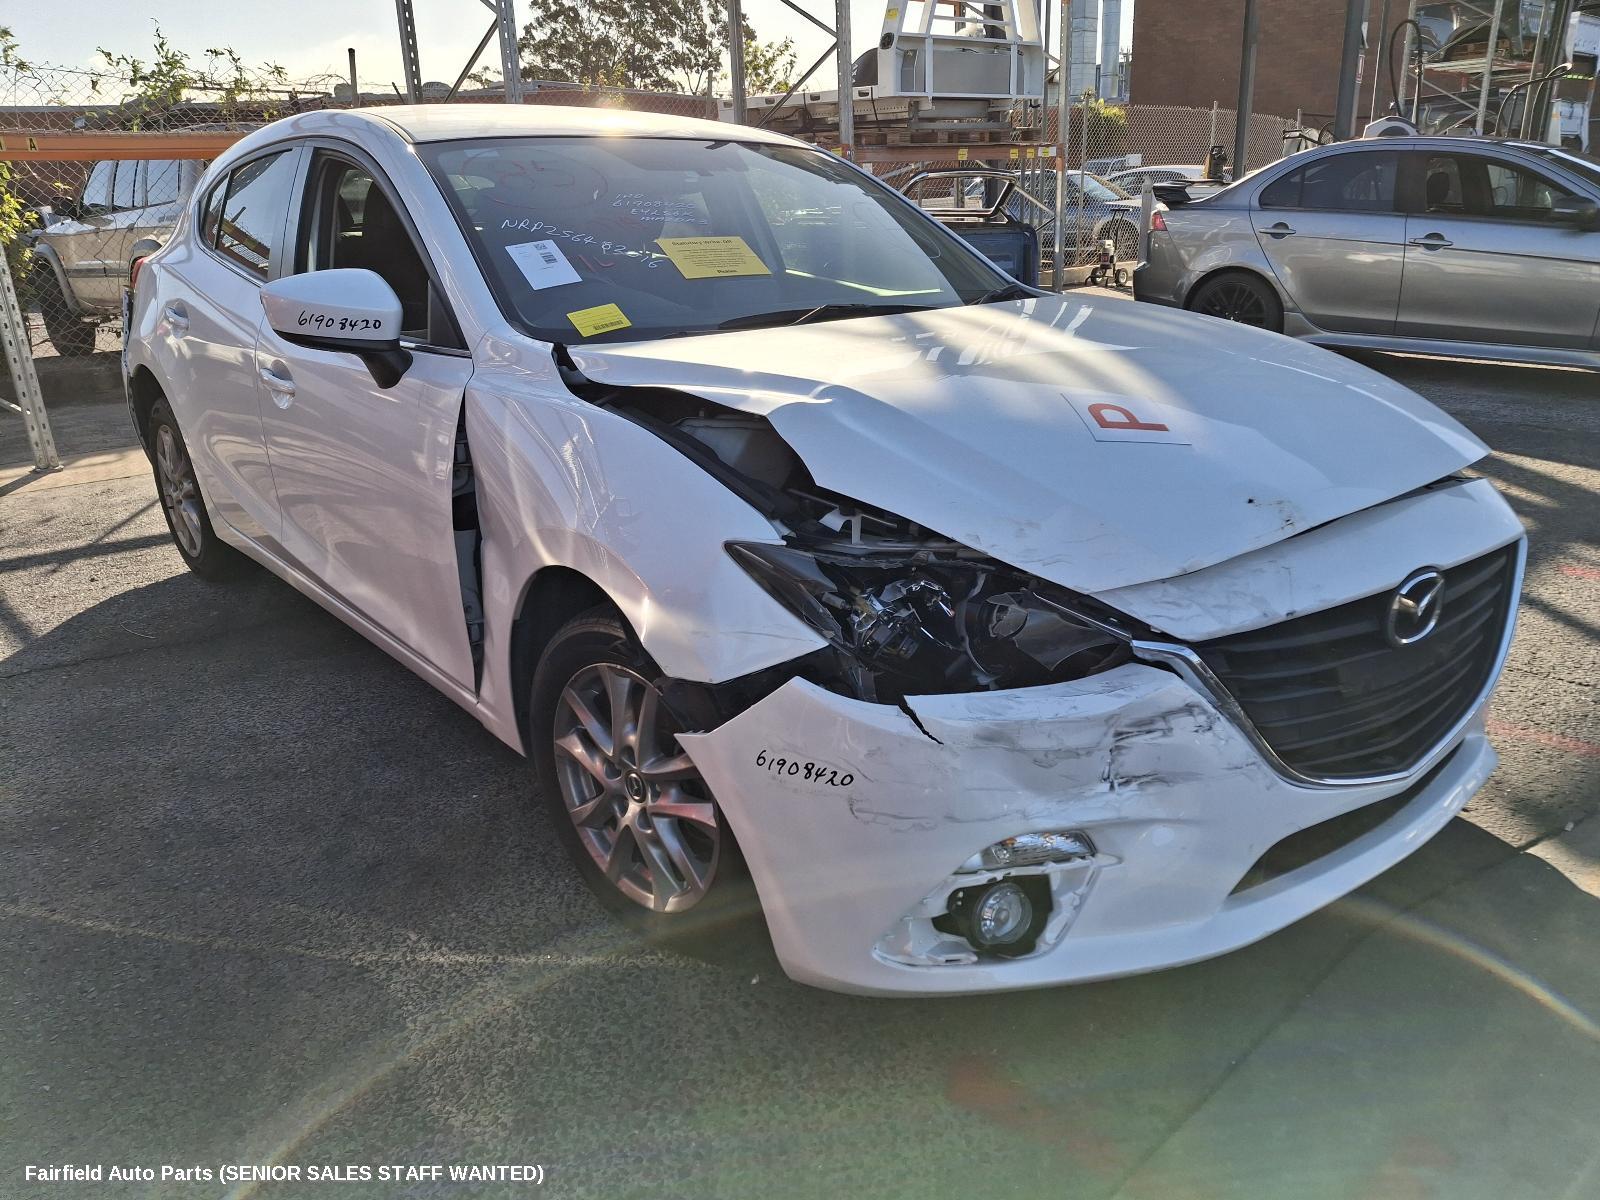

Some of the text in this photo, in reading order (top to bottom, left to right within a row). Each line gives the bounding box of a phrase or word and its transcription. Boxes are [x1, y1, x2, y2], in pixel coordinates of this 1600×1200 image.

[29, 137, 37, 151] A
[297, 310, 382, 332] 61908420
[1087, 403, 1170, 432] P
[755, 749, 855, 787] 61908420
